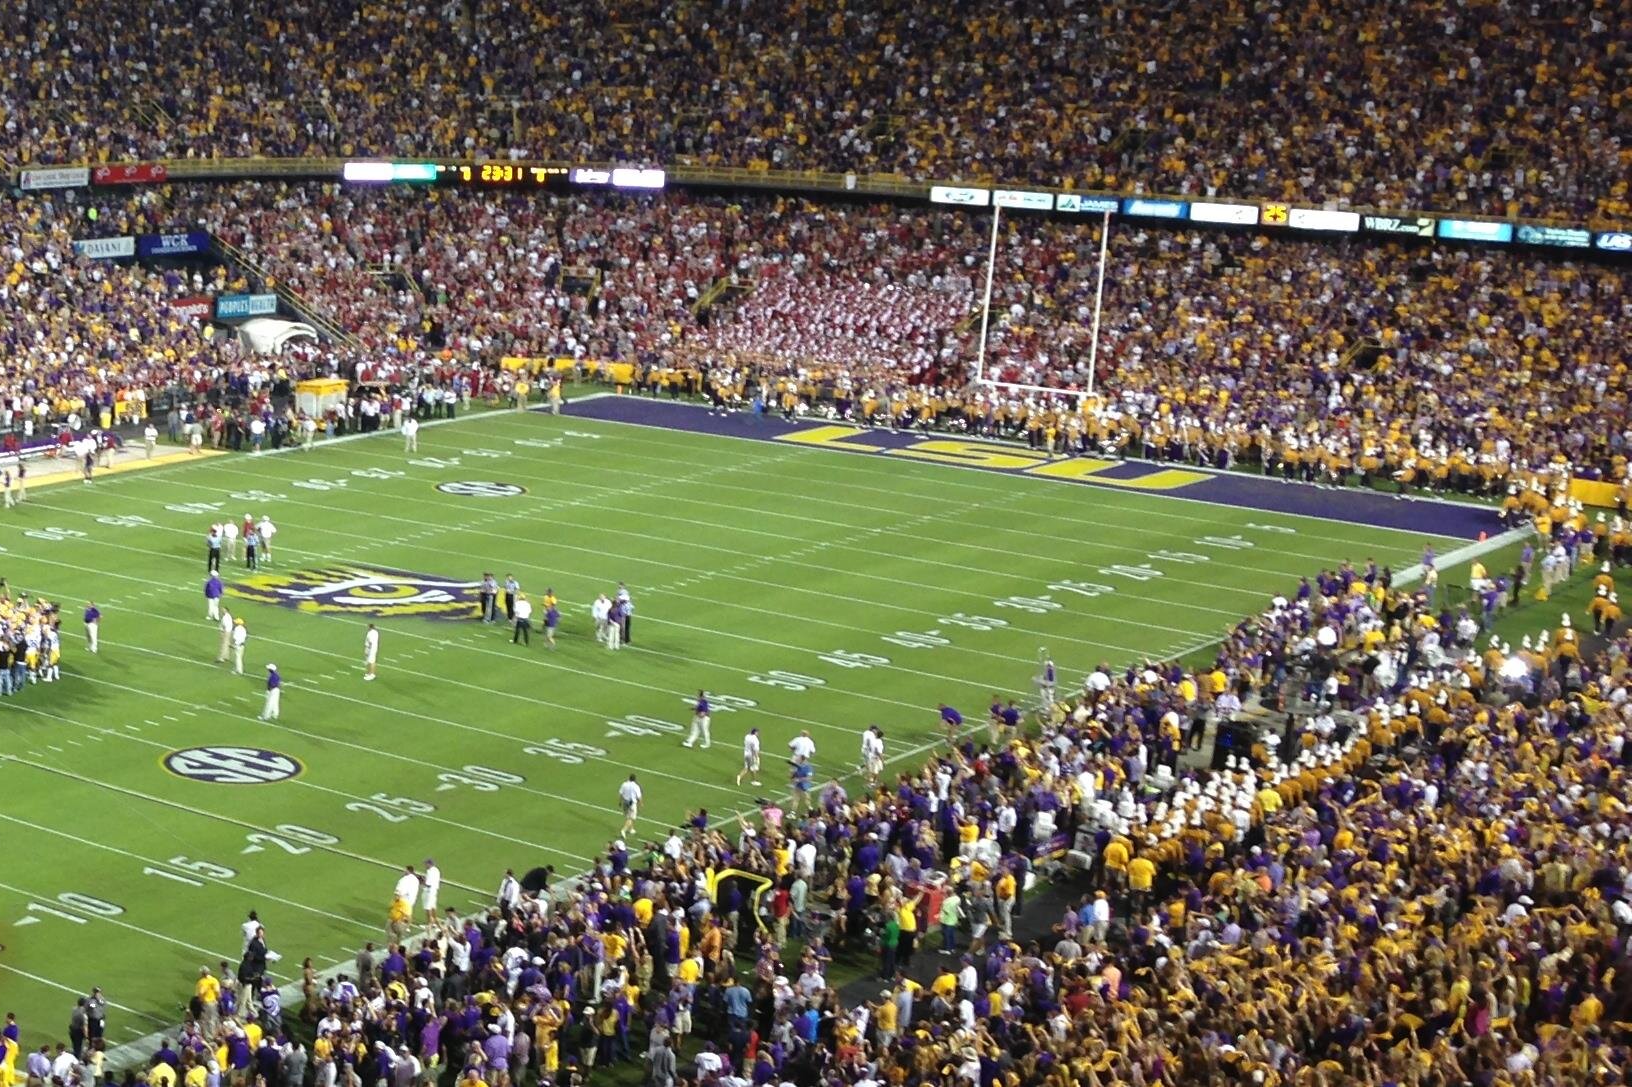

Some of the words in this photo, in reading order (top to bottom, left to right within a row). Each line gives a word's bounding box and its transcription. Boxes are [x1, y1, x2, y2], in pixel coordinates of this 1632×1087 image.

[773, 426, 1218, 489] LSU
[23, 527, 88, 540] 50
[881, 630, 951, 648] 40
[817, 650, 890, 668] 45
[748, 670, 825, 690] 50
[606, 715, 684, 736] 40
[524, 738, 608, 764] 35
[170, 747, 296, 783] SEC
[438, 765, 525, 791] 30
[346, 793, 436, 822] 25
[247, 824, 340, 854] 20
[143, 856, 236, 886] 15
[27, 892, 125, 924] 10
